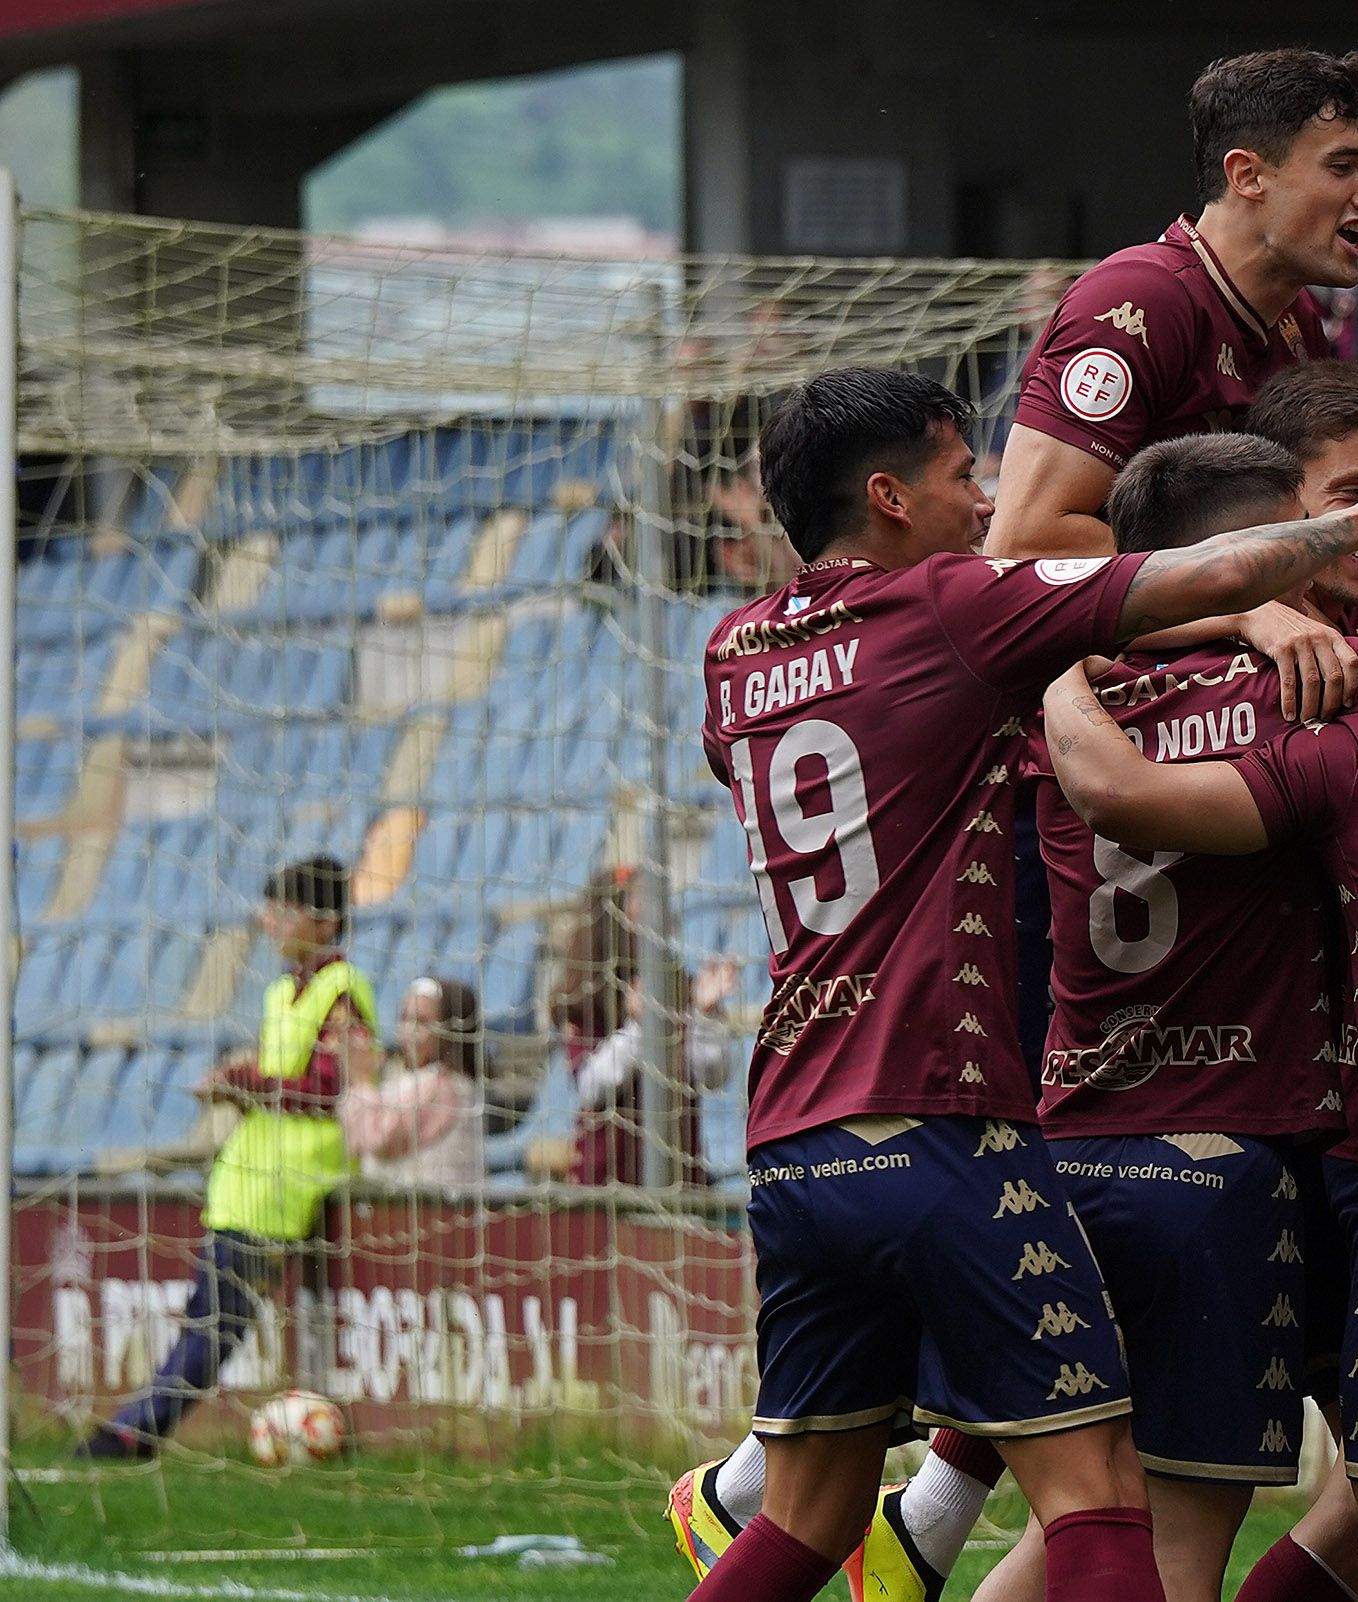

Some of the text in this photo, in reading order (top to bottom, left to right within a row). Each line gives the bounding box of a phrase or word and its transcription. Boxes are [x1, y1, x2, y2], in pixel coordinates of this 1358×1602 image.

[1090, 440, 1114, 459] NON
[808, 558, 849, 573] VOLTAR
[744, 638, 860, 718] GARAY
[1155, 702, 1256, 763] NOVO
[730, 719, 880, 955] 19
[1089, 833, 1184, 973] 8
